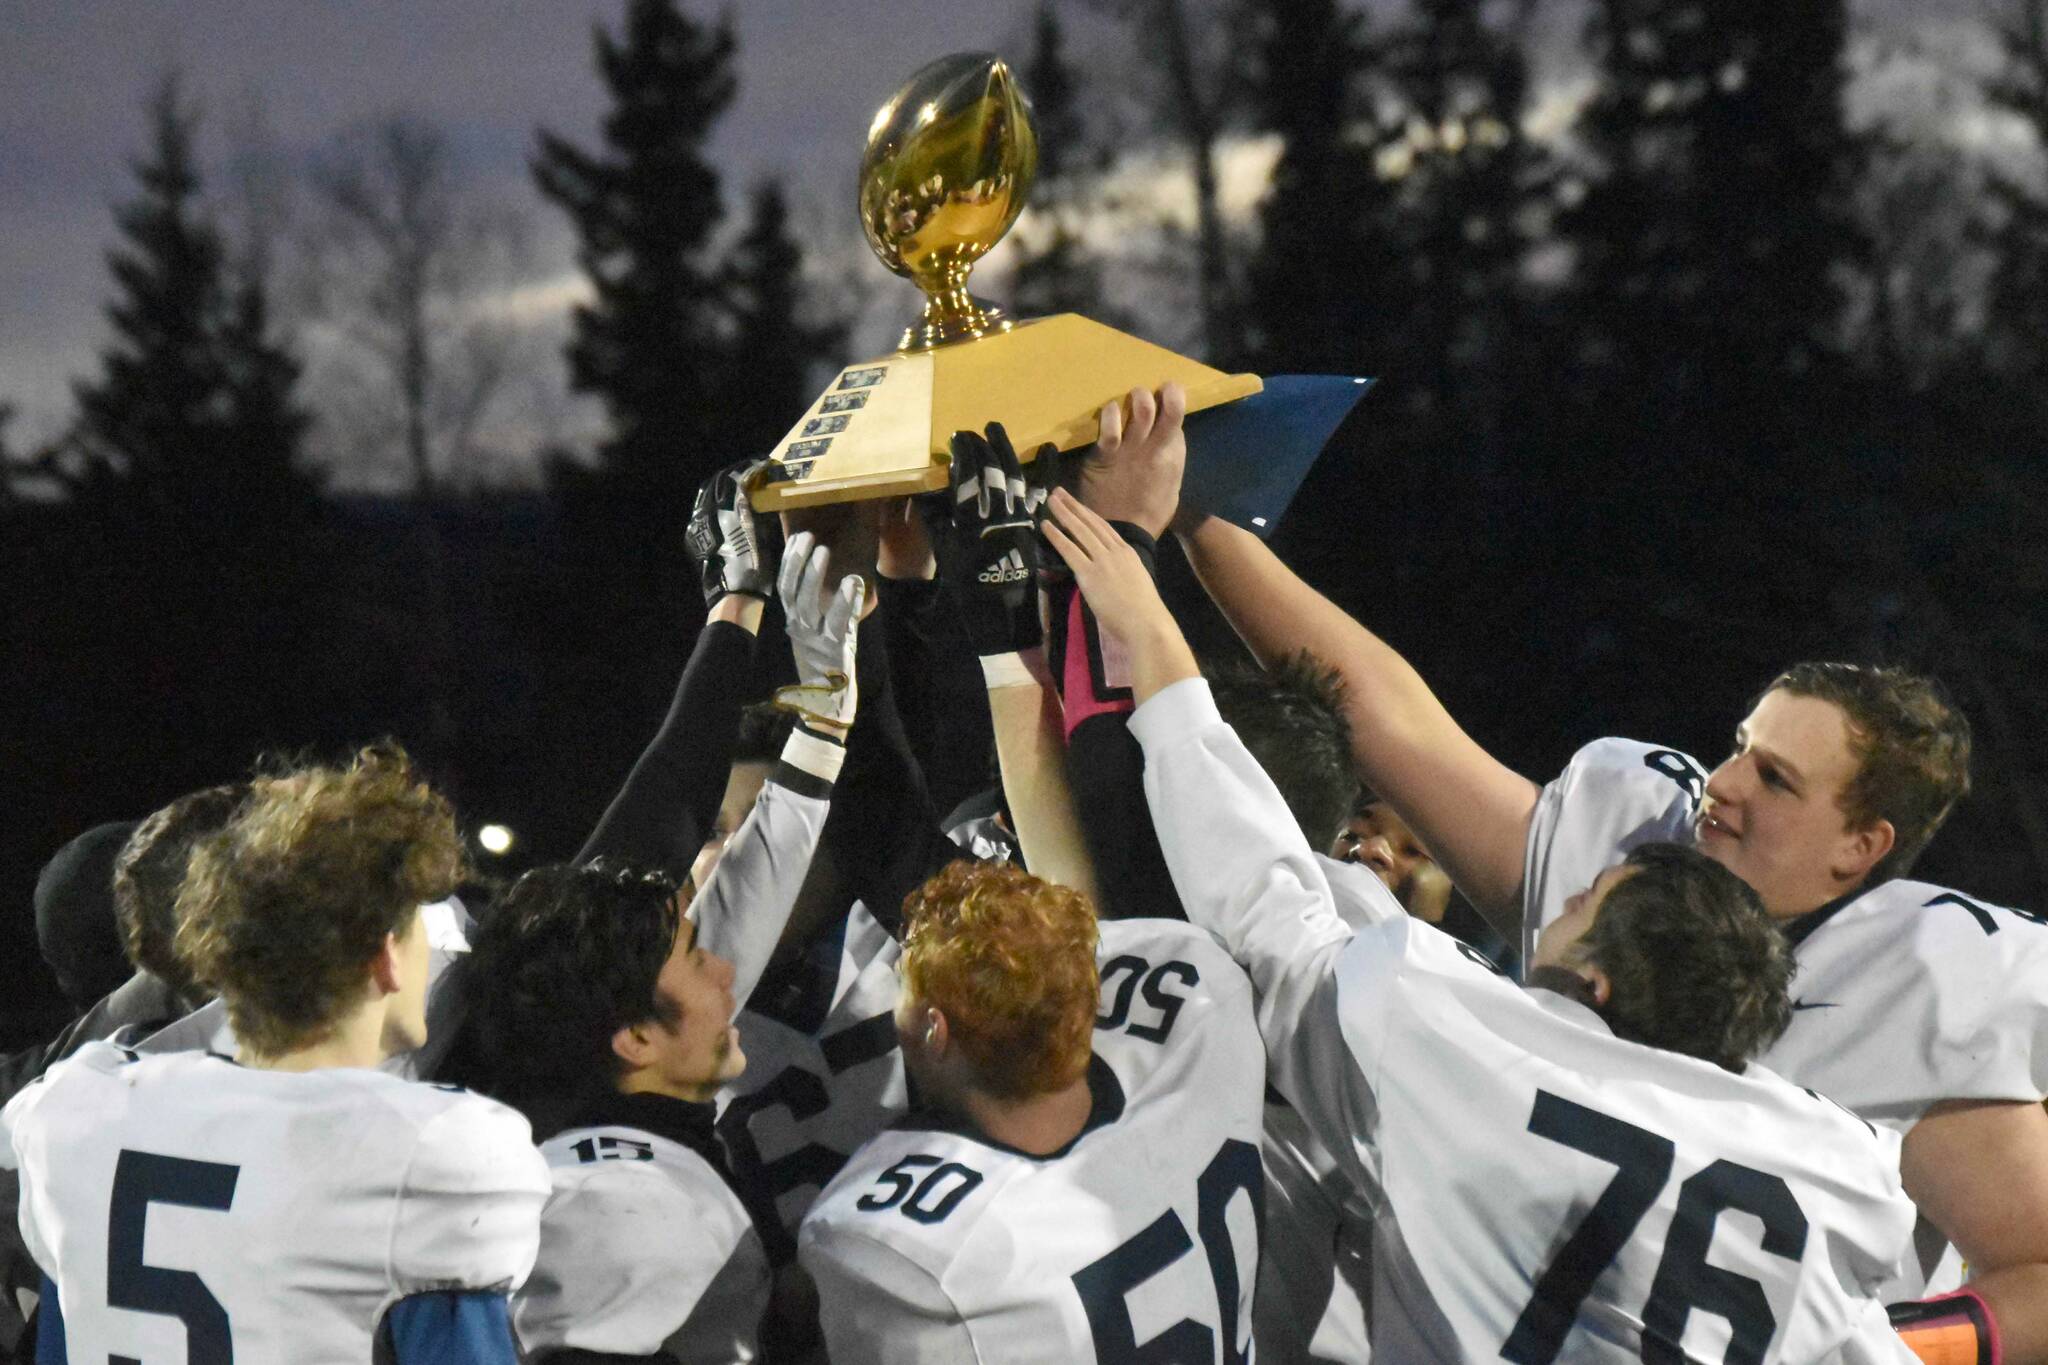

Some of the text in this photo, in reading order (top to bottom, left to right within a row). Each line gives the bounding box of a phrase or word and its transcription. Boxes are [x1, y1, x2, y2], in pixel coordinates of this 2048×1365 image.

[978, 568, 1029, 583] adidas
[1094, 954, 1200, 1045] 50
[107, 1148, 241, 1365] 5
[856, 1153, 984, 1225] 50
[1070, 1137, 1265, 1365] 50
[1498, 1087, 1808, 1365] 76
